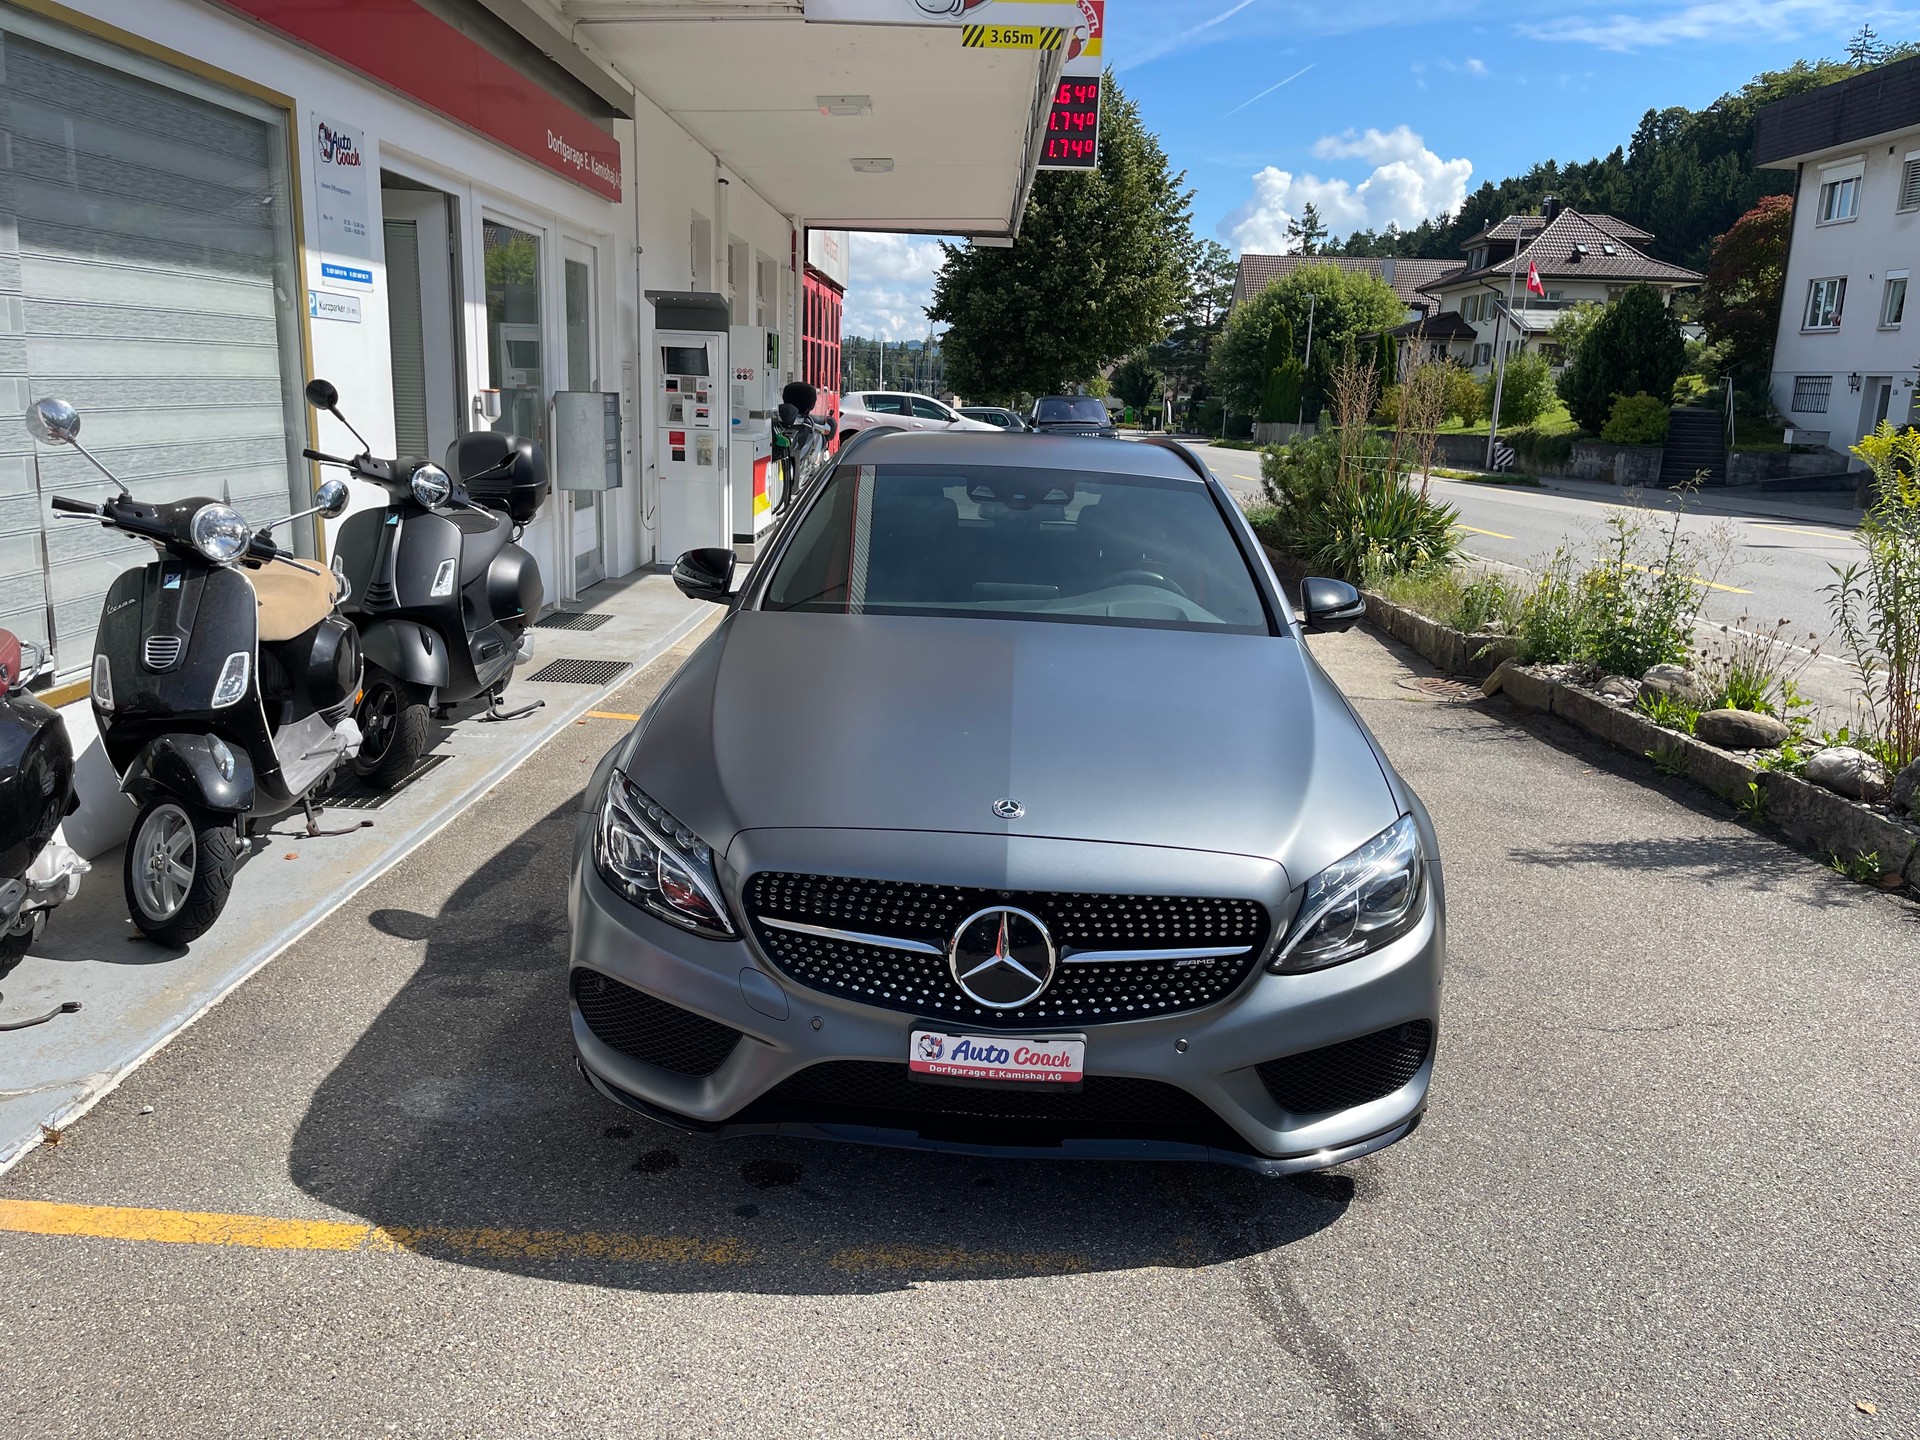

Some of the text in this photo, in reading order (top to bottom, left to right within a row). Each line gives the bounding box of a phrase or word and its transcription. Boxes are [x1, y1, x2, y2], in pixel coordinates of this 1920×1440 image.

[990, 29, 1034, 45] 3.65m
[332, 131, 352, 151] Auto
[1048, 138, 1093, 158] 1.740
[335, 147, 362, 166] Coach
[547, 128, 584, 170] Dorfgarage
[584, 151, 591, 171] E.
[590, 155, 616, 189] Kamishaj
[1187, 958, 1215, 966] AMG
[950, 1039, 1072, 1068] Auto Coach
[929, 1064, 1062, 1081] Dorfgarage E.Kamishaj AG
